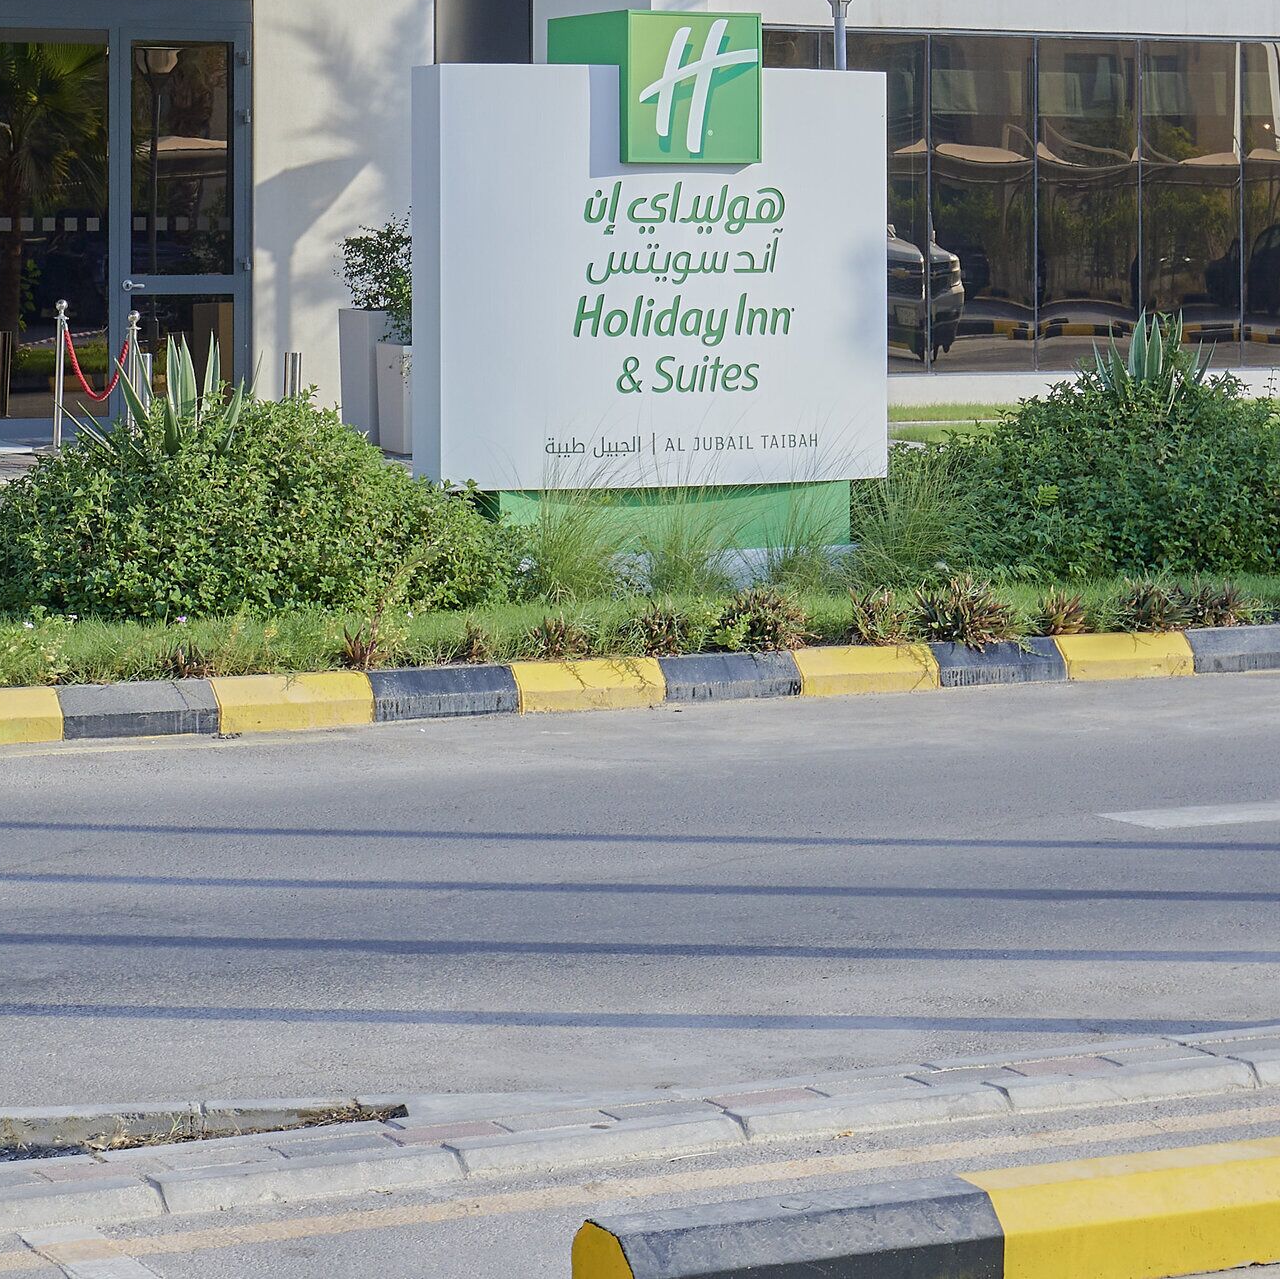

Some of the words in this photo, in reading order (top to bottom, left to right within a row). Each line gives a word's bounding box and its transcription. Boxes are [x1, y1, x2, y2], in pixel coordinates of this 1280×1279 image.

[583, 181, 622, 235] إن
[627, 181, 786, 235] هوليداي
[586, 243, 729, 285] سويتس
[733, 228, 783, 273] آند
[573, 293, 729, 347] Holiday
[734, 292, 791, 336] Inn
[616, 356, 643, 394] &
[651, 355, 760, 394] Suites
[544, 436, 585, 458] طيبة
[593, 436, 641, 458] الجبيل
[665, 437, 686, 452] AL
[693, 435, 754, 452] JUBAIL
[761, 433, 818, 450] TAIBAH
